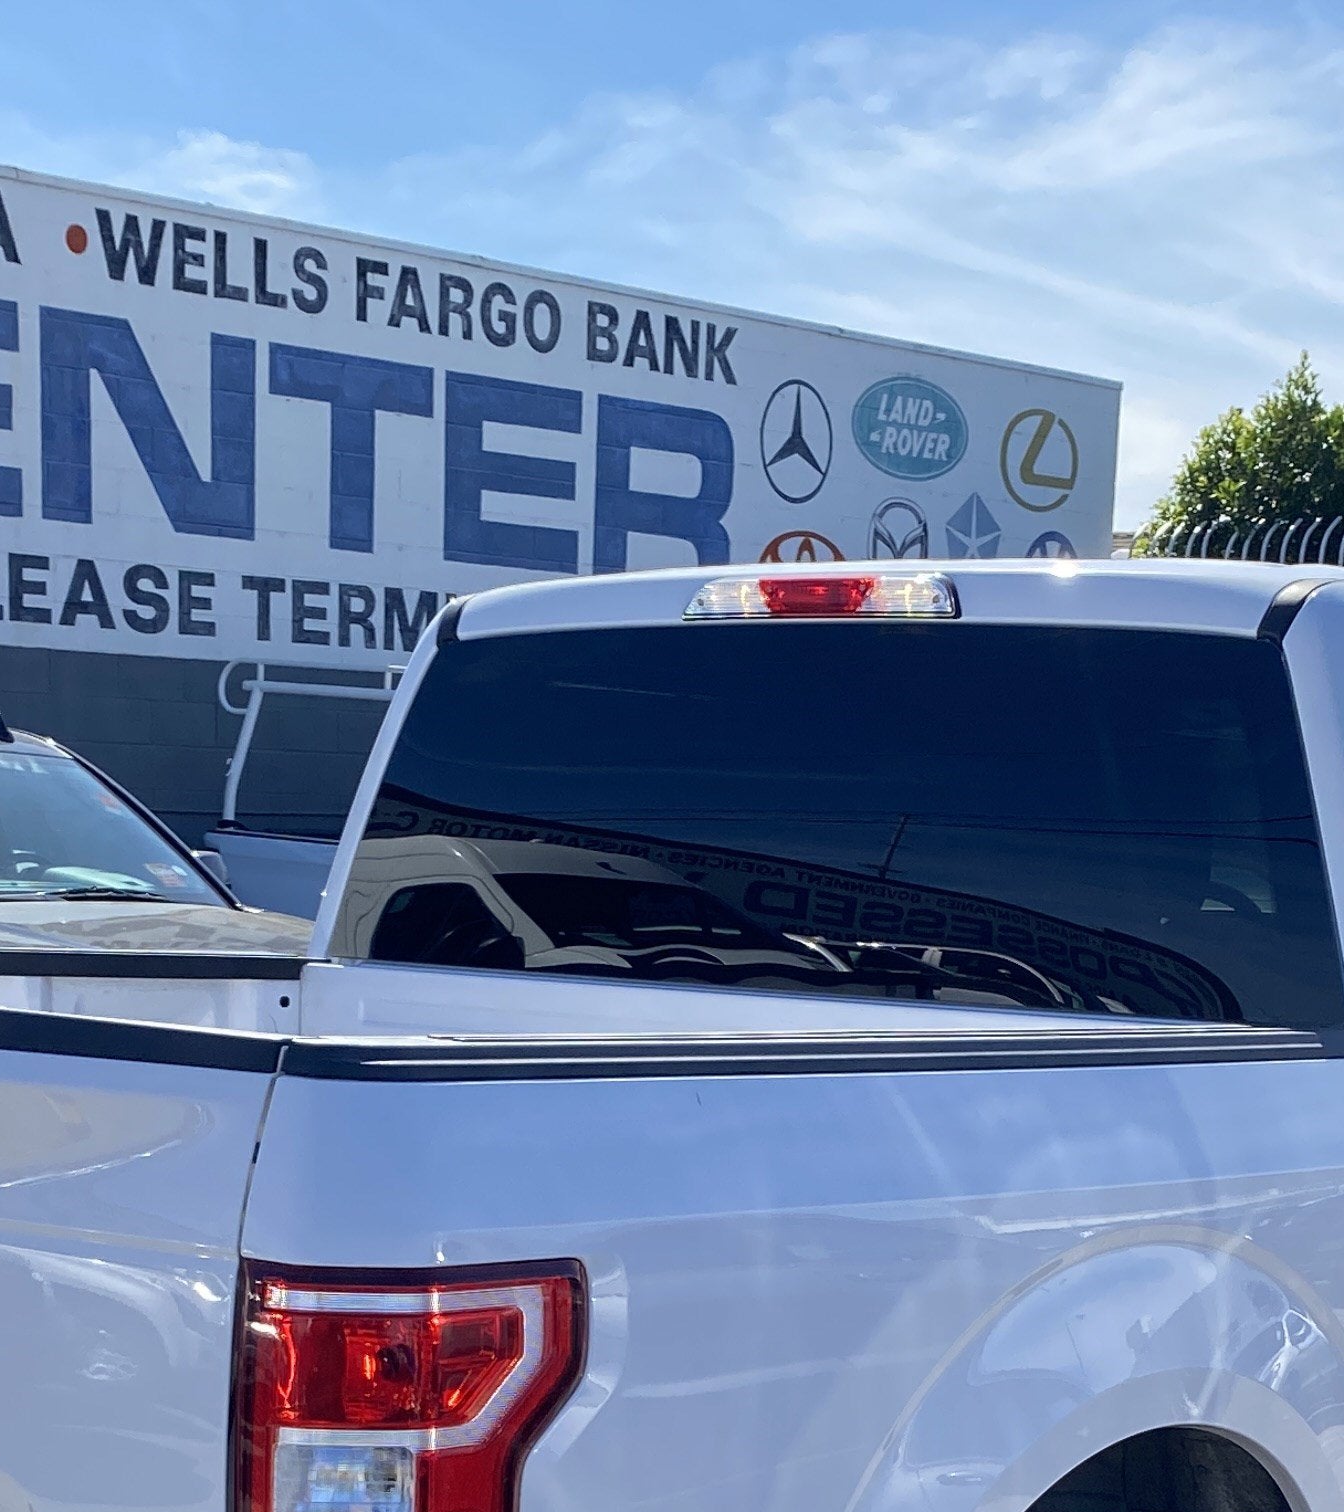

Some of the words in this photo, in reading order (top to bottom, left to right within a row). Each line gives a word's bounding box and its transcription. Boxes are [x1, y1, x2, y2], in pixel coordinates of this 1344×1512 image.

[95, 208, 329, 314] WELLS
[355, 257, 561, 354] FARGO
[587, 301, 739, 386] BANK
[242, 575, 456, 653] TERM
